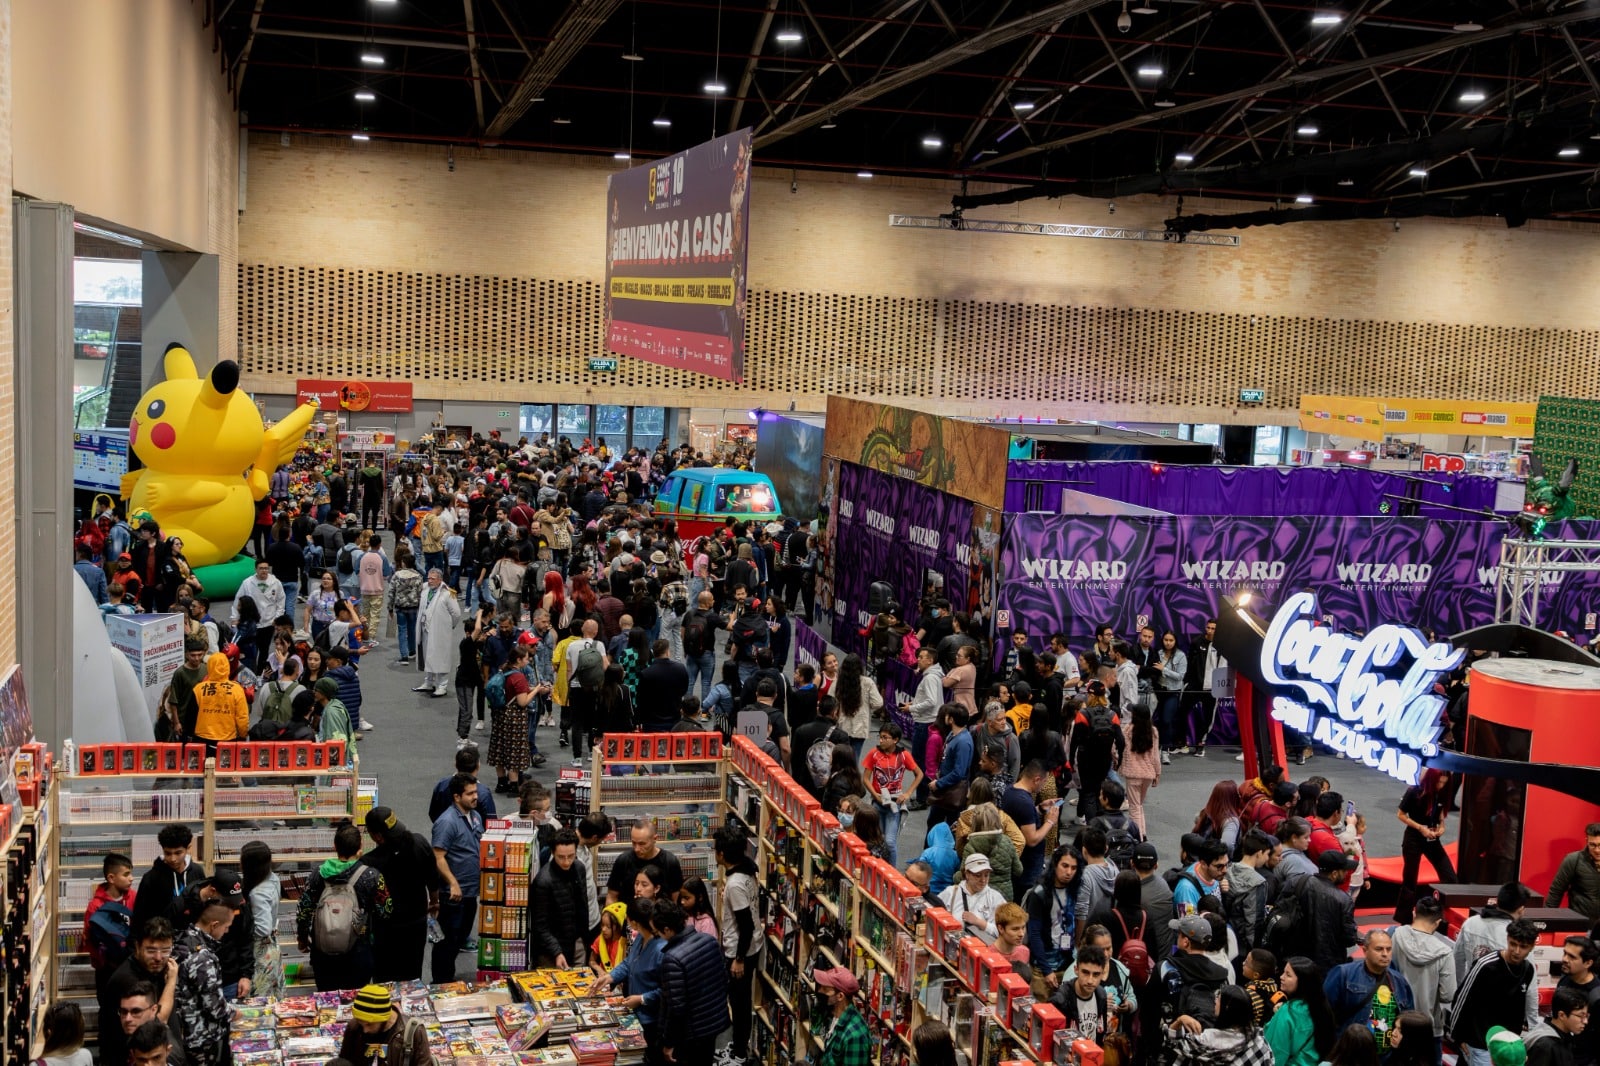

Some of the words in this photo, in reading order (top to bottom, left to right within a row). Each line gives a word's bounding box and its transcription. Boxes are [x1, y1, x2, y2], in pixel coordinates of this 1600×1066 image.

[672, 157, 684, 195] 10
[613, 220, 679, 261] BIENVENIDOS
[680, 219, 690, 258] A
[693, 212, 733, 257] CASA
[866, 508, 895, 534] WIZARD
[909, 524, 940, 550] WIZARD
[1021, 558, 1126, 580] WIZARD
[1181, 560, 1285, 581] WIZARD
[1337, 562, 1432, 583] WIZARD
[1029, 581, 1125, 590] ENTERTAINMENT
[1187, 581, 1282, 590] ENTERTAINMENT
[1340, 583, 1427, 592] ENTERTAINMENT
[744, 725, 760, 735] 101
[1271, 697, 1315, 733] SIN
[1314, 717, 1421, 785] AZÚCAR
